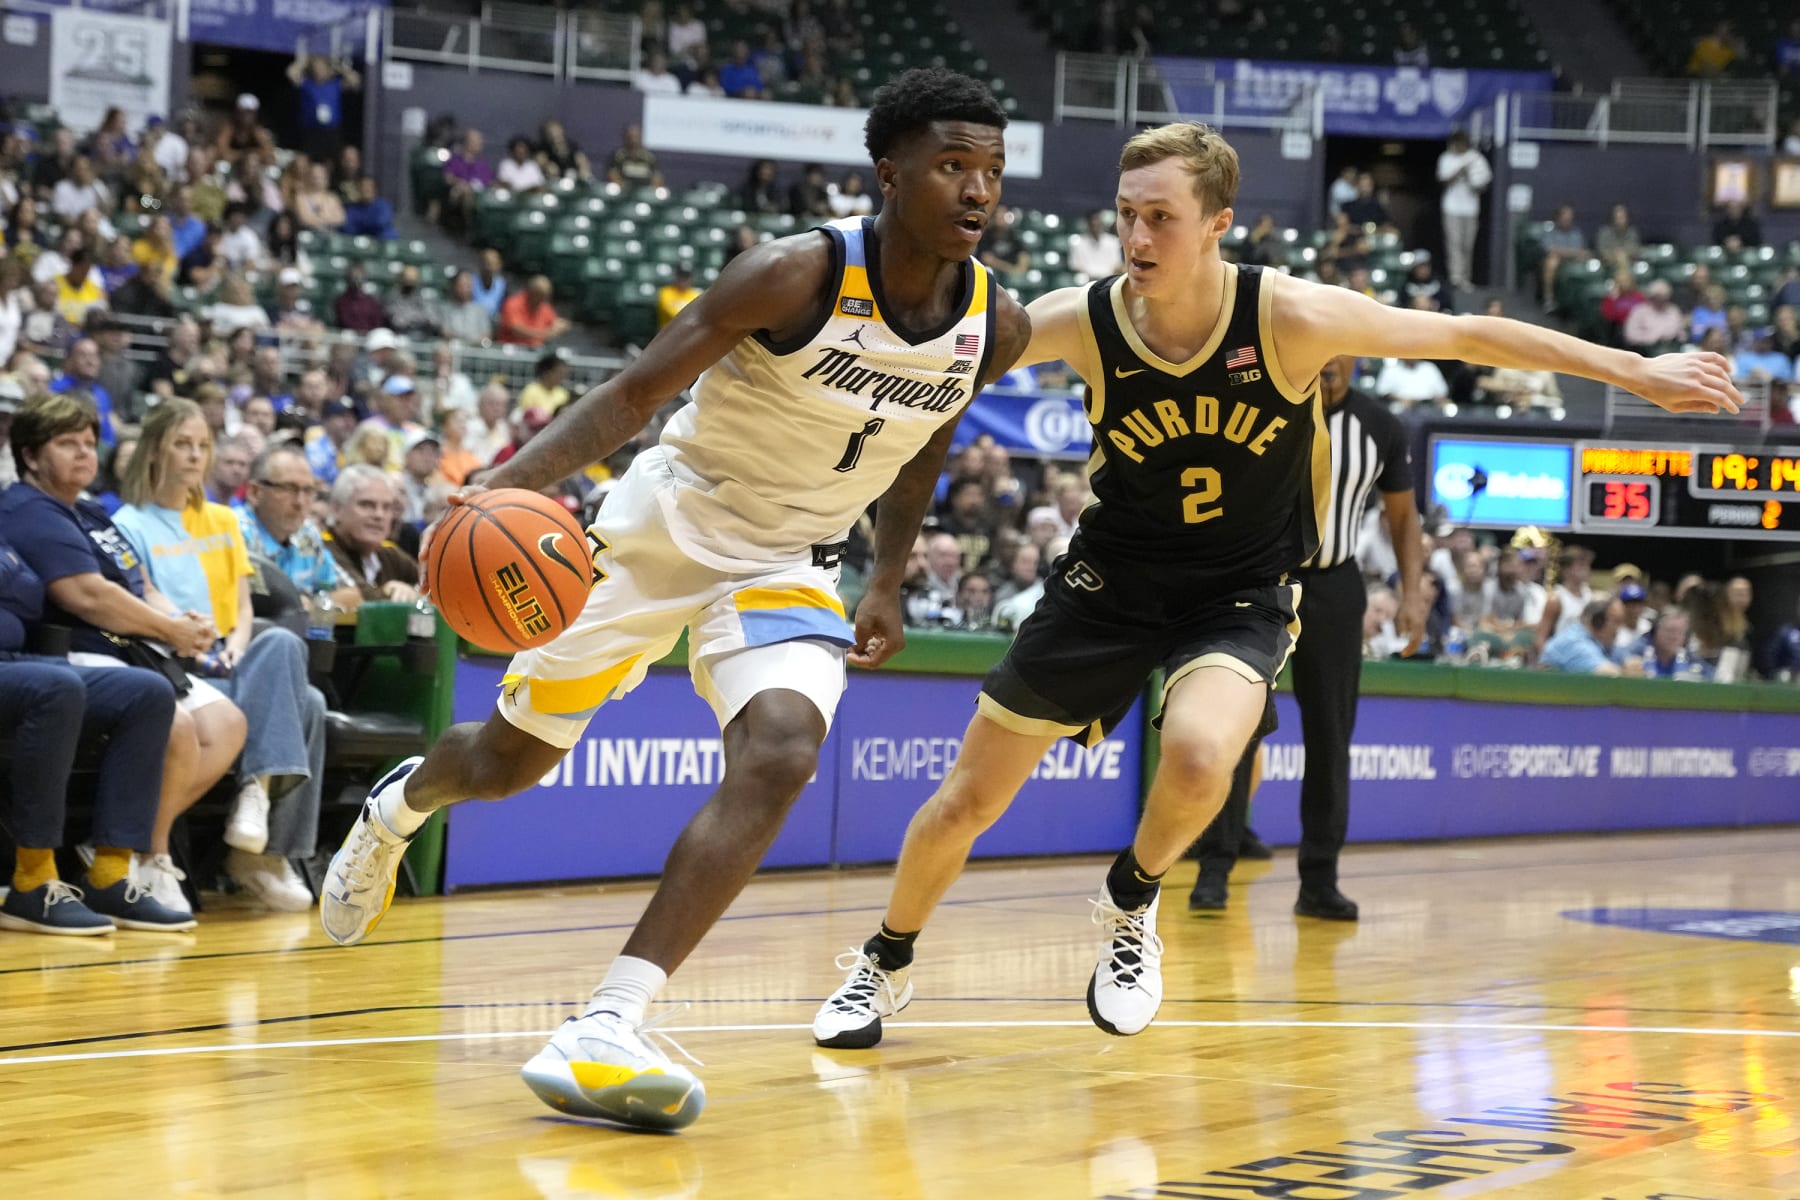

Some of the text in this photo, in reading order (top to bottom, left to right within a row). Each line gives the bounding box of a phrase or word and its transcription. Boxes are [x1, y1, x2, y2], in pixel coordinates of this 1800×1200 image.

[801, 347, 965, 413] Marquette
[833, 417, 885, 473] 1
[1107, 395, 1289, 464] PURDUE
[1180, 467, 1223, 524] 2
[1604, 480, 1650, 520] 35
[496, 561, 552, 637] ELITE
[1064, 560, 1104, 591] P
[1349, 744, 1437, 780] TATIONAL
